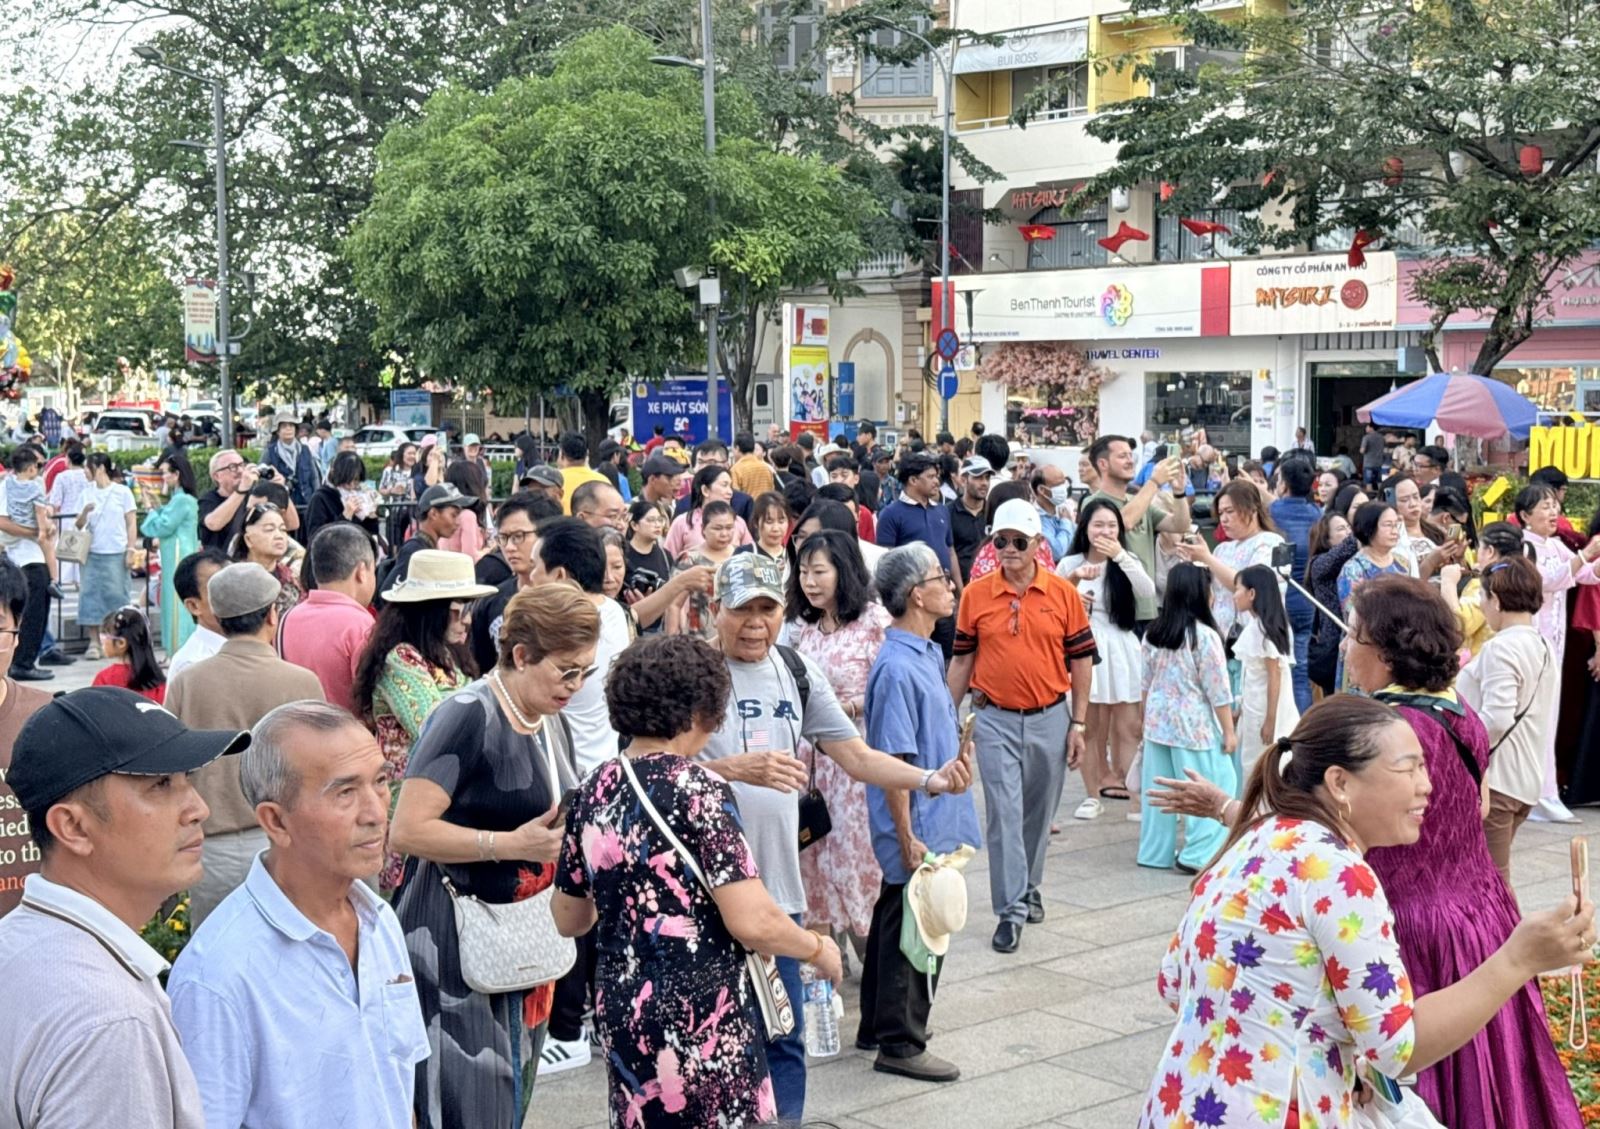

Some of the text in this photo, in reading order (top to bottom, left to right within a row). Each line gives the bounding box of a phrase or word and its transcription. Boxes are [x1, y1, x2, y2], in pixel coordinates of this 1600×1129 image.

[1015, 51, 1038, 64] ROSS
[1282, 265, 1293, 275] TY
[1334, 262, 1347, 272] AN
[1121, 348, 1160, 359] CENTER
[648, 399, 709, 414] XE PHÁT SÓN
[737, 699, 799, 721] SA
